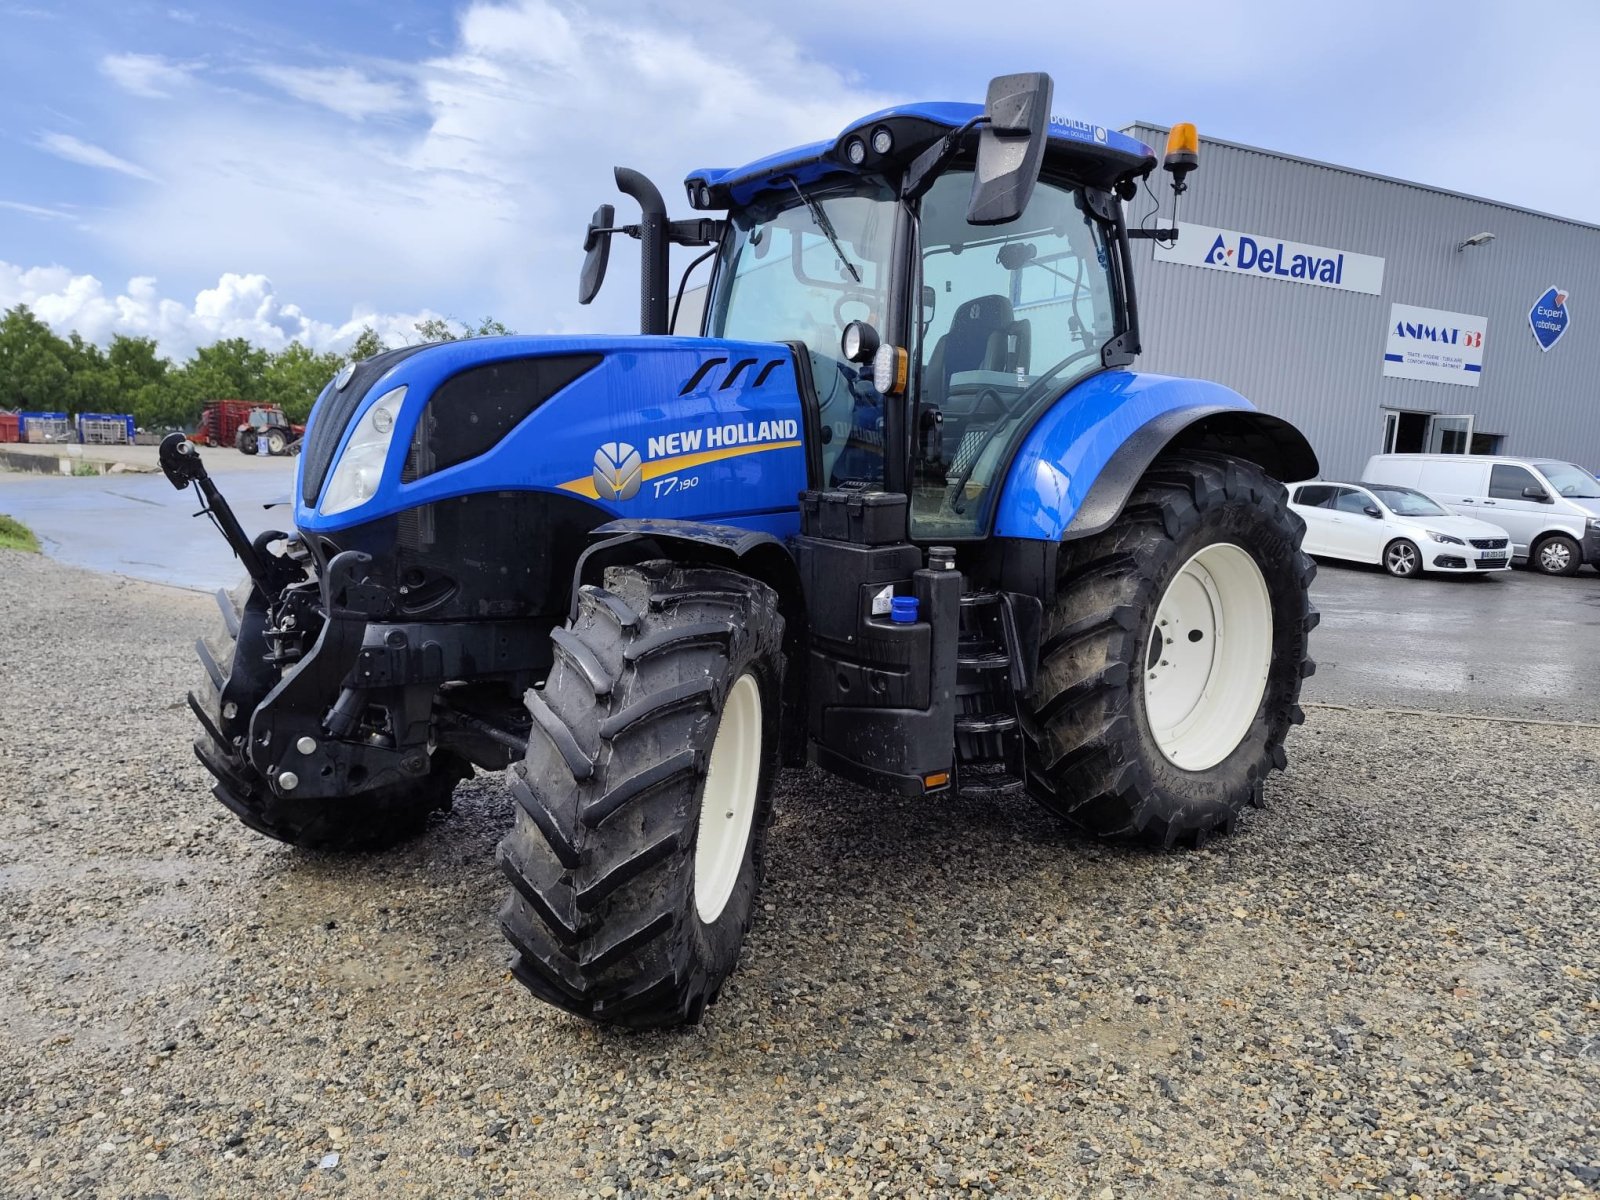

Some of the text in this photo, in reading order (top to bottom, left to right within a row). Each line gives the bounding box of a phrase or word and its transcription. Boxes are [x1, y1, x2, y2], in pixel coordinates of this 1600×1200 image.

[1237, 236, 1343, 285] DeLaval
[1537, 306, 1563, 318] Expert
[1391, 320, 1483, 348] ANIMAT 53
[1535, 320, 1562, 332] robotique
[648, 419, 798, 459] NEW HOLLAND
[653, 476, 699, 499] T7.190
